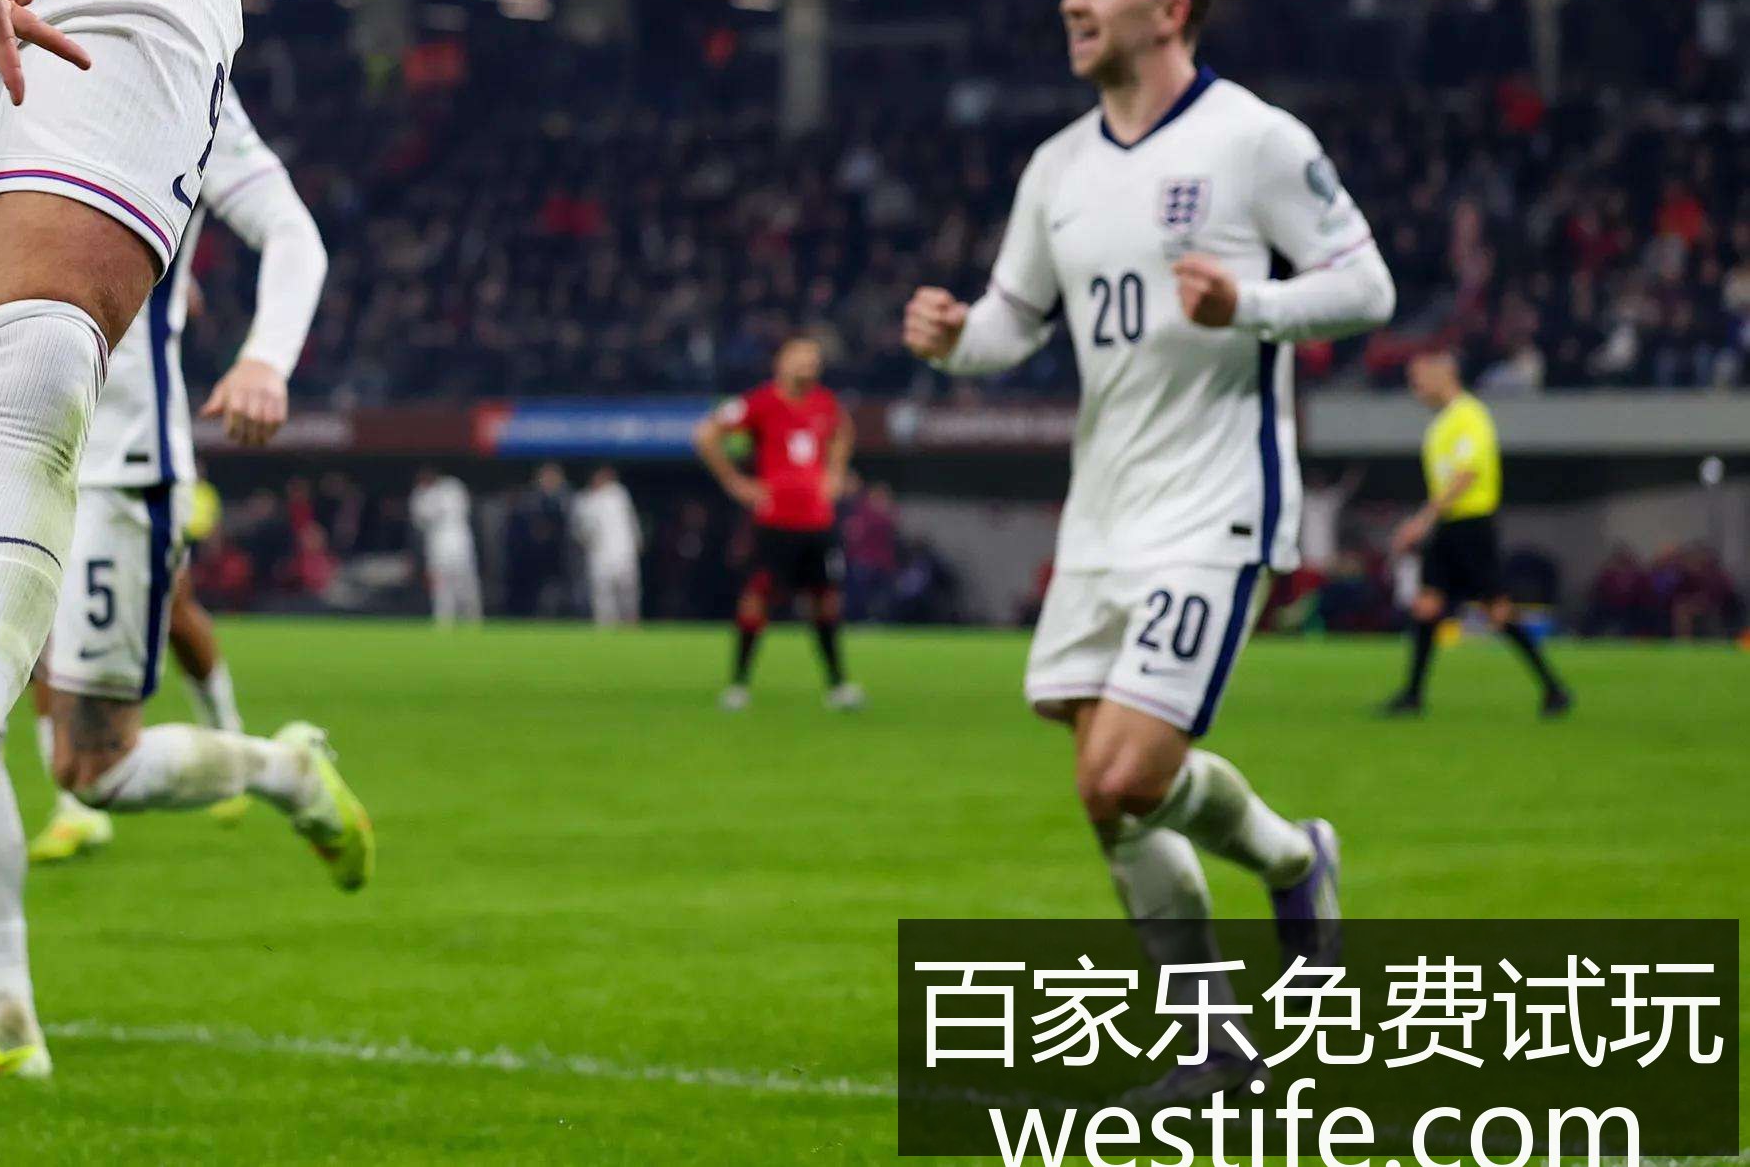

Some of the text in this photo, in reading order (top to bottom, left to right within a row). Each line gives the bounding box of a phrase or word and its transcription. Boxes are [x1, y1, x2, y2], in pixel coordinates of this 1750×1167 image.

[1089, 272, 1145, 348] 20
[87, 559, 115, 630] 5
[1137, 589, 1210, 662] 20
